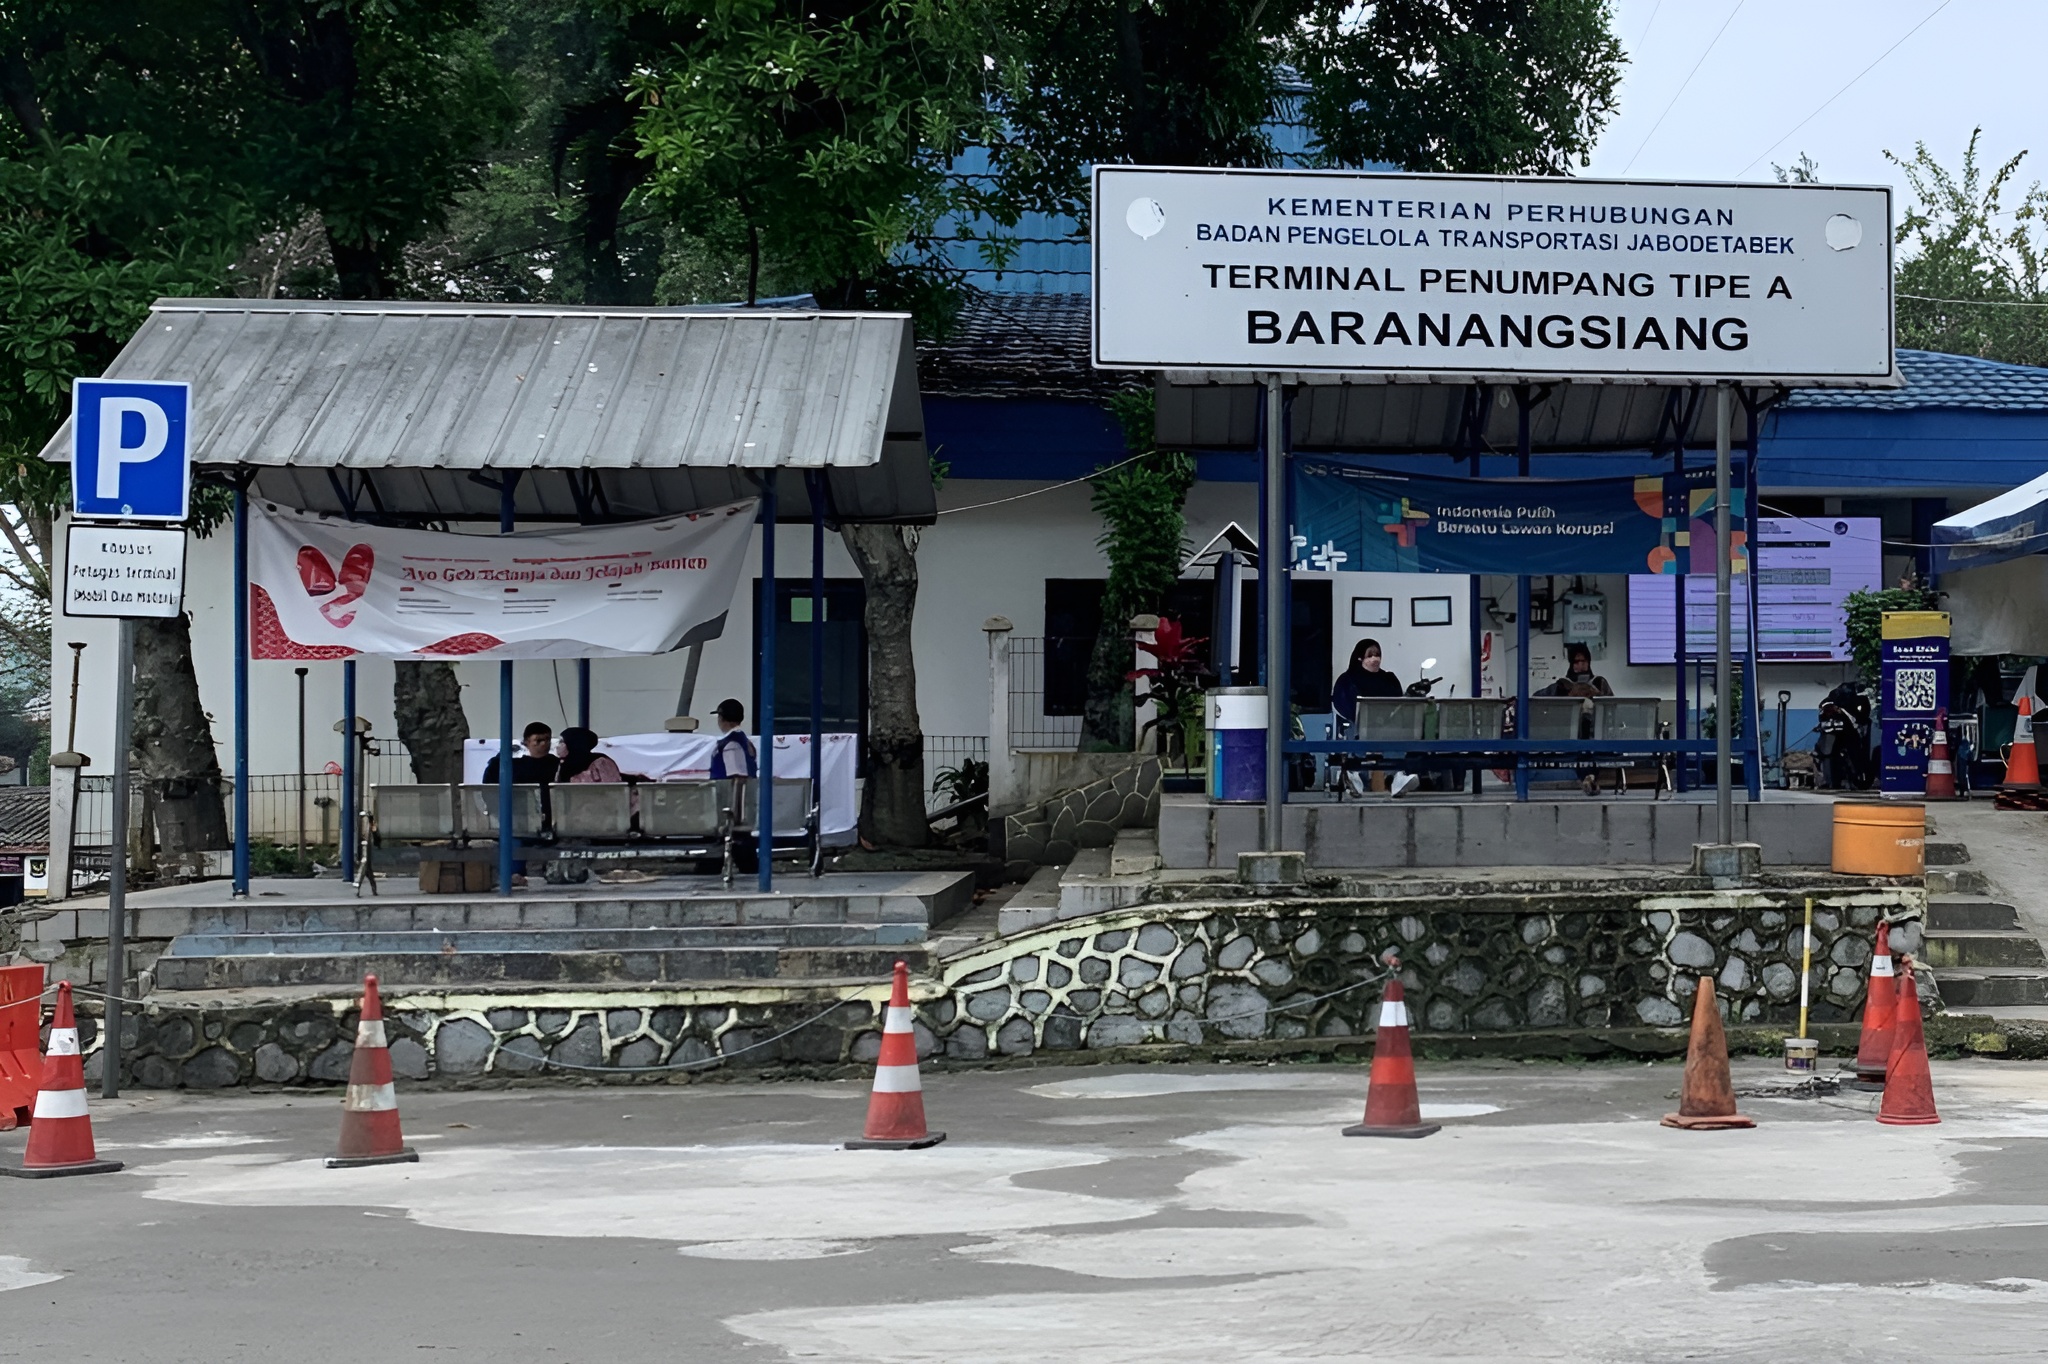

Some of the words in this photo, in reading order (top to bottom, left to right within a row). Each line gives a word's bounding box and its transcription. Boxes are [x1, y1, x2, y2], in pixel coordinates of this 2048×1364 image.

[1269, 198, 1491, 220] KEMENTERIAN
[1507, 204, 1733, 226] PERHUBUNGAN
[1196, 223, 1280, 243] BADAN
[1287, 226, 1430, 247] PENGELOLA
[1438, 229, 1619, 251] TRANSPORTASI
[1626, 233, 1795, 255] JABODETABEK
[1202, 263, 1406, 292] TERMINAL
[1420, 268, 1655, 297] PENUMPANG
[1670, 273, 1751, 299] TIPE
[1766, 275, 1793, 300] A
[1247, 310, 1749, 352] BARANANGSIANG
[97, 397, 168, 499] P
[1437, 506, 1512, 519] Indonesia
[1516, 506, 1556, 519] Pulih
[1437, 521, 1497, 535] Bersatu
[1501, 523, 1552, 535] Lawan
[1556, 521, 1614, 537] Korupsi
[127, 566, 176, 580] Terminal
[402, 567, 437, 582] Ayo
